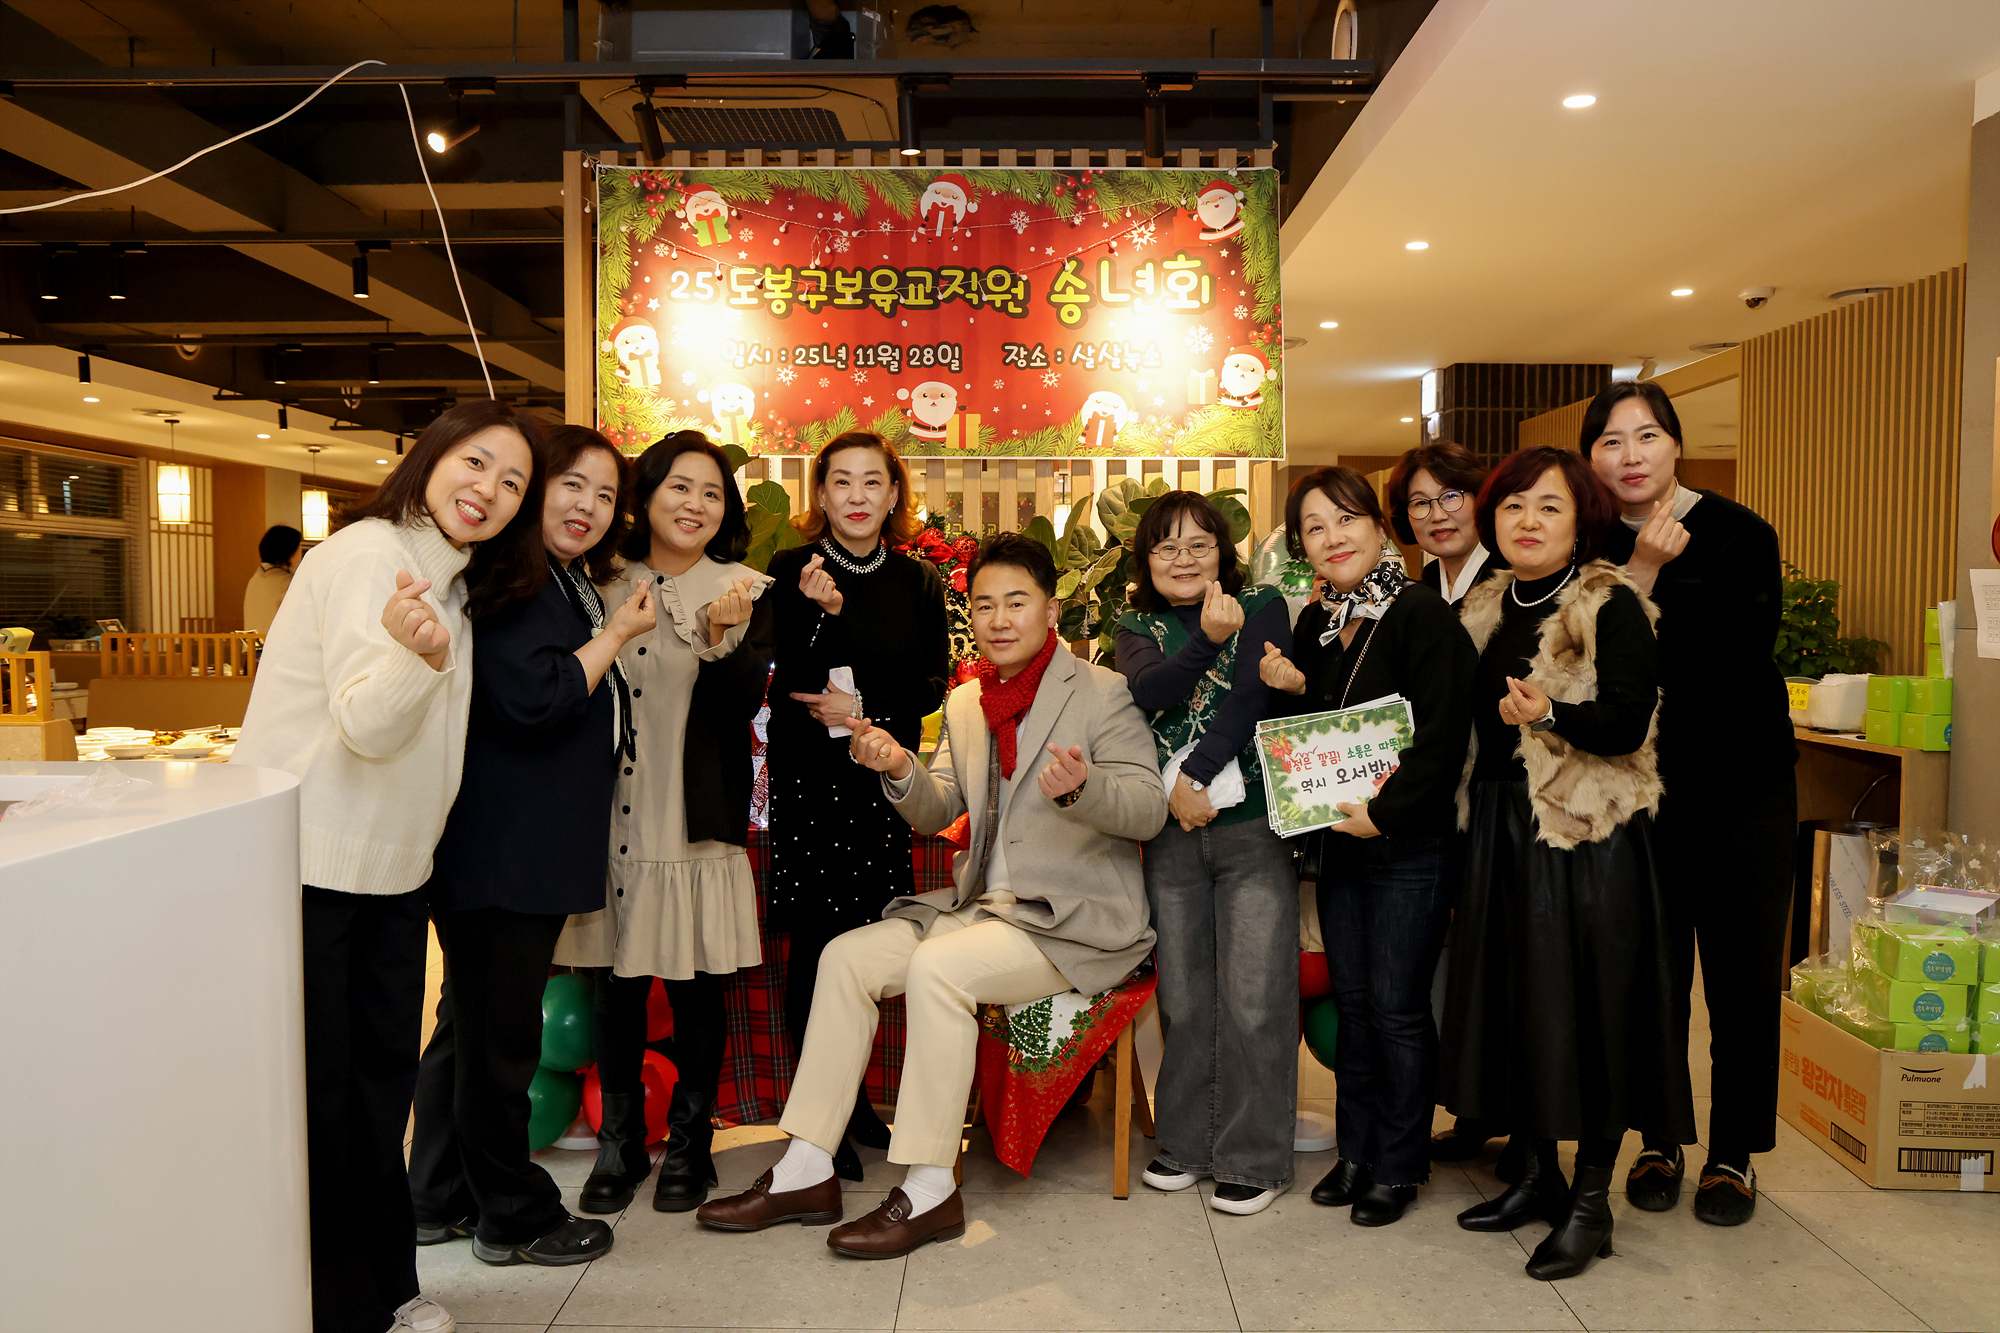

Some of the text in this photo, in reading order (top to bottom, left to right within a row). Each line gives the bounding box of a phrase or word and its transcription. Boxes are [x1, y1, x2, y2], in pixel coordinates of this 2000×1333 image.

[670, 254, 1210, 324] 25 도봉구보육교직원 송년회
[722, 340, 771, 367] 일시
[794, 345, 847, 369] 25년
[856, 344, 899, 371] 11월
[909, 344, 960, 371] 28일
[1004, 345, 1047, 367] 장소
[1072, 343, 1161, 371] 살살녹소
[1281, 737, 1403, 774] 행정은 깔끔! 소통은 따뜻!
[1301, 759, 1394, 794] 역시 오서방!
[1839, 900, 1853, 919] STEEL
[1802, 1056, 1843, 1111] 왕감자
[1901, 1073, 1942, 1083] Pulmuone
[1843, 1102, 1866, 1126] 핫도그
